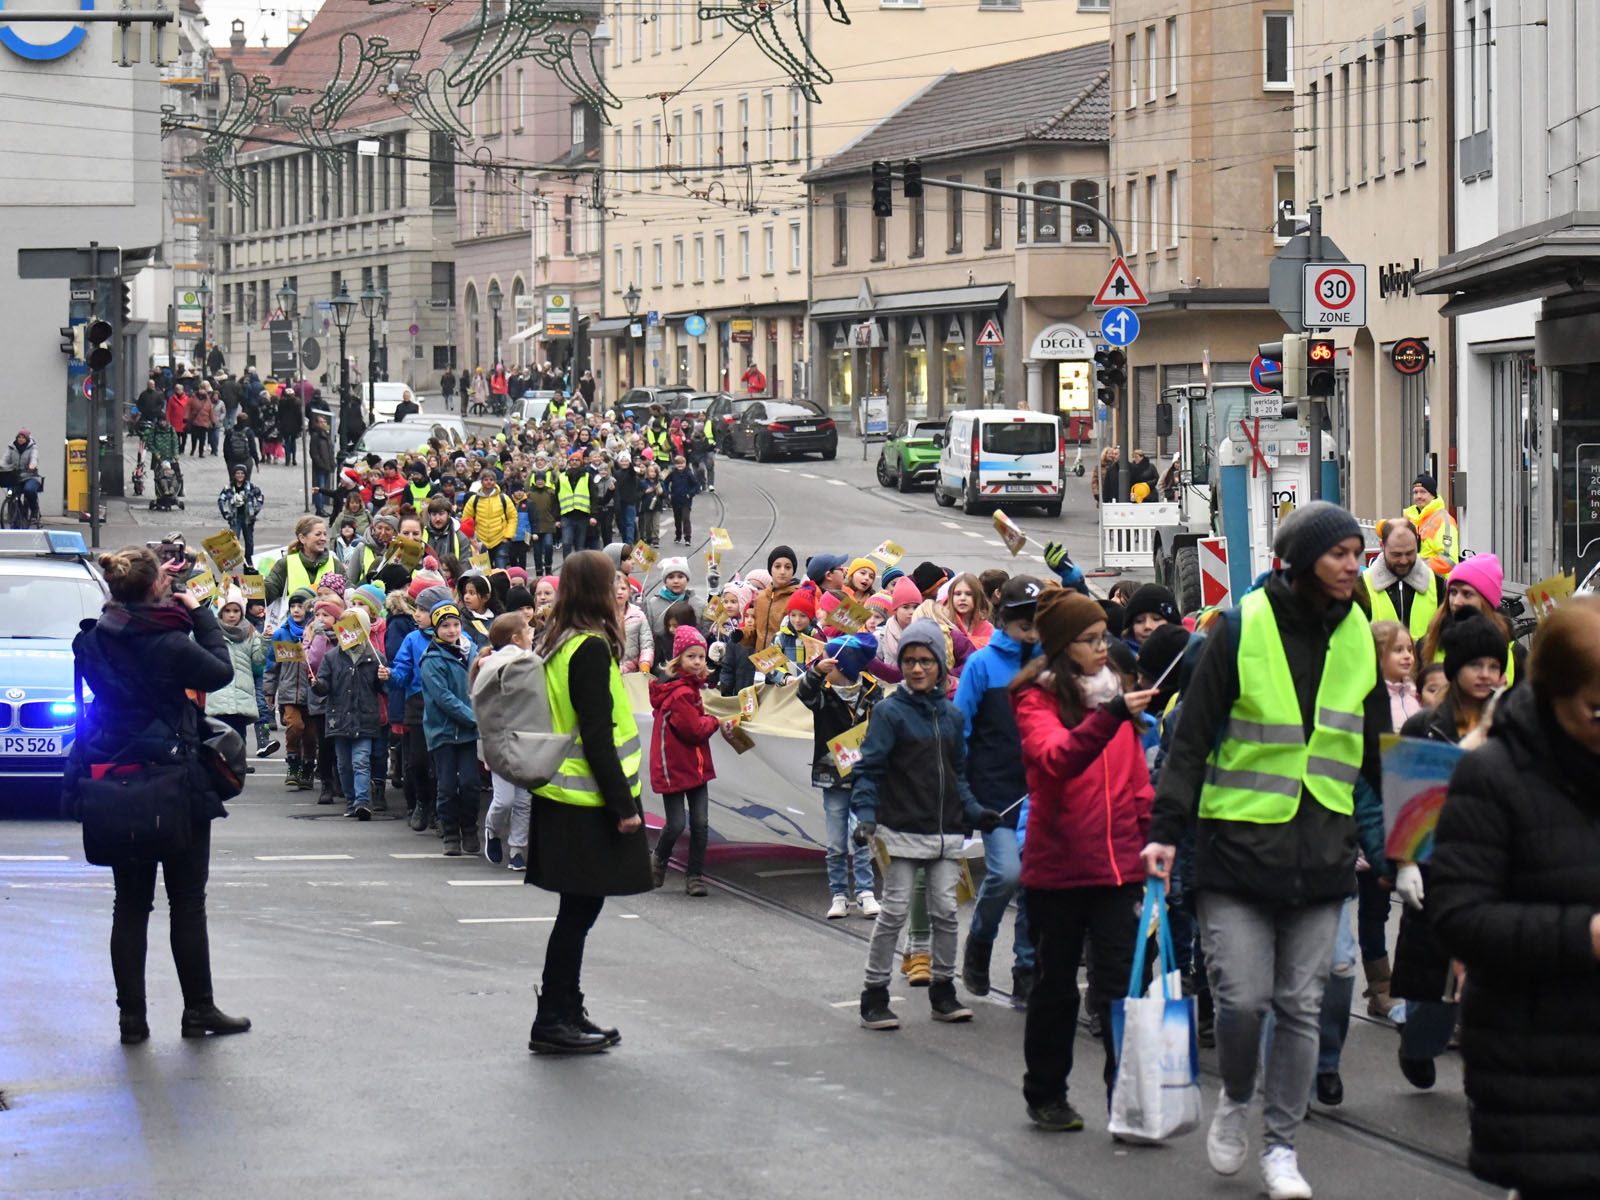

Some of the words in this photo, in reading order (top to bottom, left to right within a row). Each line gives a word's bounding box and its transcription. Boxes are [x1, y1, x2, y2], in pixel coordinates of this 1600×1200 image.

[1323, 280, 1347, 299] 30
[1319, 313, 1351, 322] ZONE
[1040, 338, 1085, 349] DEGLE
[1272, 491, 1296, 505] TOI
[1591, 511, 1598, 519] &
[5, 738, 24, 752] PS
[28, 738, 56, 752] 526
